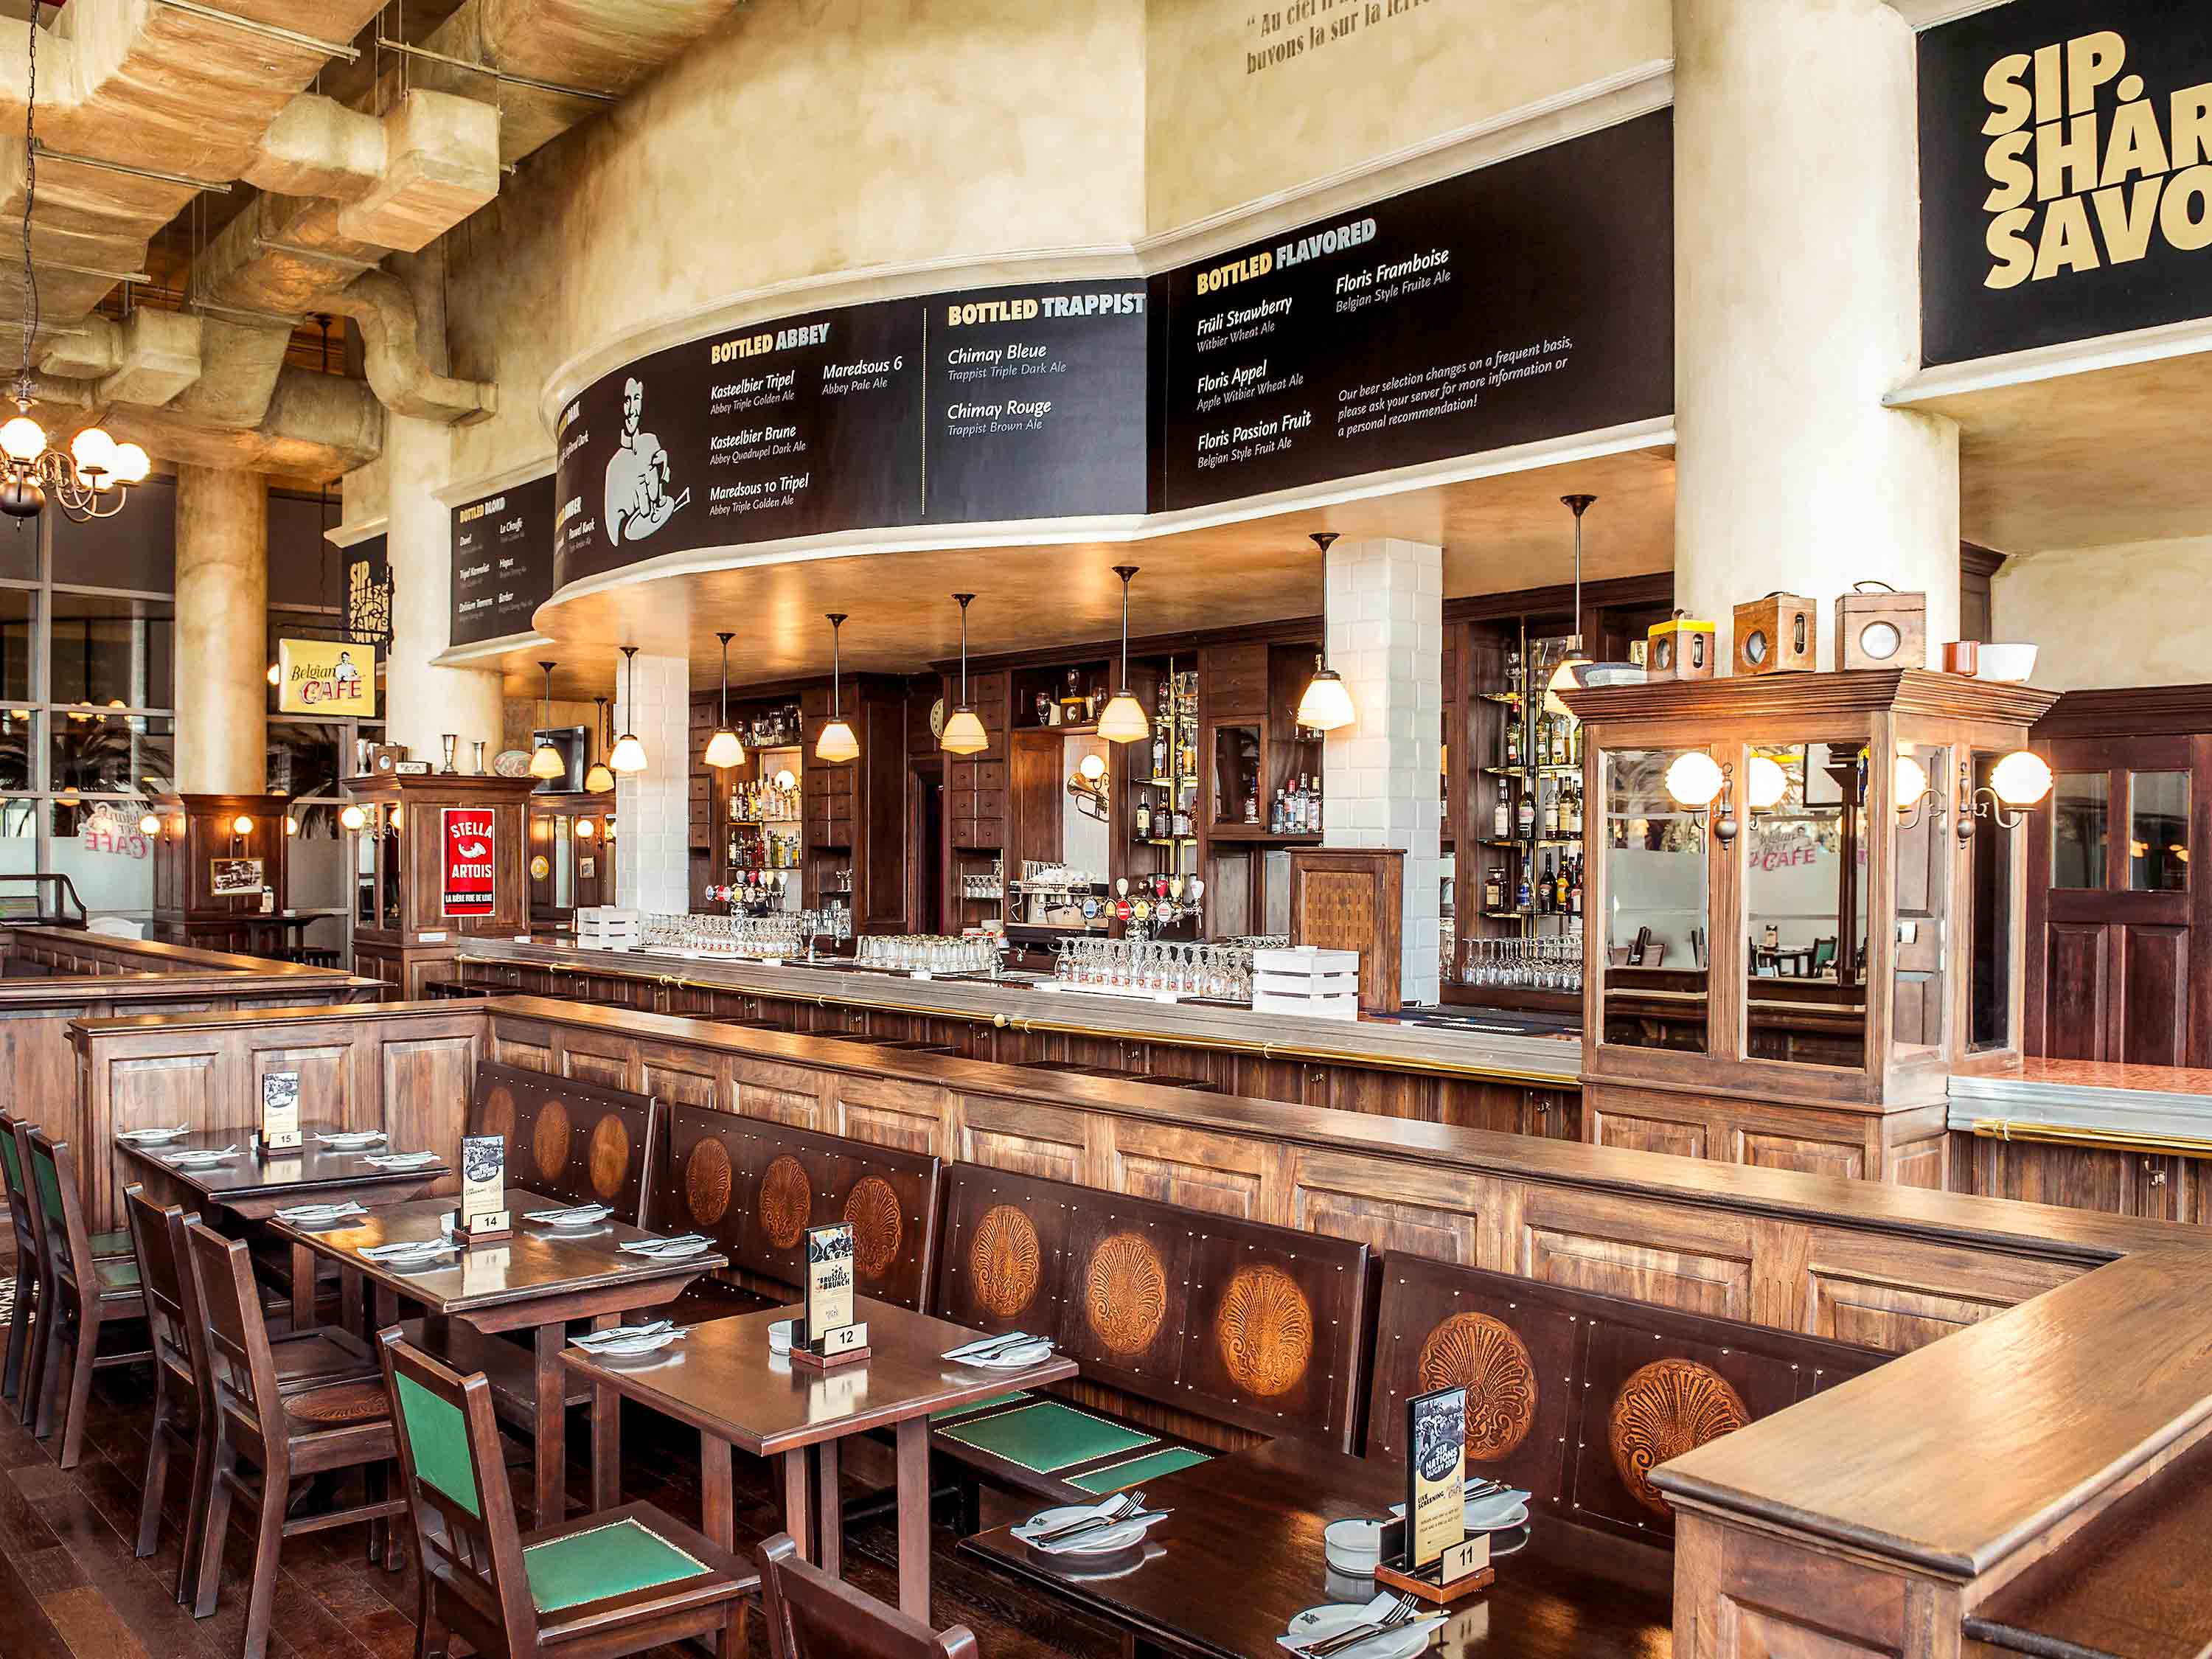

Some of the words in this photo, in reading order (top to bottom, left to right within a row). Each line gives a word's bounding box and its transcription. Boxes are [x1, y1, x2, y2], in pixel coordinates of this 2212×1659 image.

[1261, 12, 1281, 37] Au
[1247, 35, 1304, 74] buvons
[1310, 26, 1324, 49] la
[1331, 13, 1358, 41] sur
[1365, 3, 1380, 27] la
[1981, 30, 2144, 136] SIP.
[1197, 252, 1273, 296] BOTTLED
[1276, 218, 1377, 270] FLAVORED
[1336, 270, 1372, 294] Floris
[1376, 248, 1449, 282] Framboise
[1336, 295, 1371, 313] Belgian
[1374, 285, 1399, 302] Style
[1402, 277, 1431, 294] Fruite
[1433, 269, 1451, 285] Ale
[948, 299, 1038, 326] BOTTLED
[1042, 293, 1147, 318] TRAPPIST
[1197, 313, 1223, 335] Früli
[1226, 297, 1292, 327] Strawberry
[711, 334, 773, 364] BOTTLED
[776, 323, 830, 351] ABBEY
[1197, 335, 1228, 352] Witbier
[1231, 327, 1258, 343] Wheat
[1261, 320, 1275, 335] Ale
[947, 348, 1002, 365] Chimay
[1007, 343, 1047, 359] Bleue
[823, 360, 890, 380] Maredsous
[894, 355, 902, 370] 6
[948, 368, 987, 383] Trappist
[990, 364, 1018, 378] Triple
[1021, 363, 1046, 375] Dark
[1050, 361, 1067, 372] Ale
[1197, 372, 1229, 394] Floris
[1231, 359, 1267, 387] Appel
[1338, 389, 1357, 402] Our
[1360, 385, 1380, 397] beer
[1382, 373, 1423, 392] selection
[1425, 363, 1467, 381] changes
[1469, 359, 1483, 371] on
[1485, 357, 1492, 366] a
[1493, 344, 1540, 369] frequent
[1543, 336, 1573, 353] basis,
[711, 378, 763, 400] Kasteelbier
[765, 369, 795, 391] Tripel
[822, 383, 849, 395] Abbey
[851, 379, 871, 392] Pale
[873, 378, 888, 389] Ale
[1196, 394, 1221, 413] Apple
[1223, 387, 1255, 403] Witbier
[1258, 378, 1287, 395] Wheat
[1289, 373, 1304, 387] Ale
[1338, 406, 1366, 423] please
[1368, 397, 1385, 412] ask
[1387, 395, 1409, 411] your
[1411, 388, 1440, 403] server
[1439, 382, 1457, 400] for
[1458, 378, 1485, 392] more
[1488, 361, 1552, 387] information
[1555, 358, 1568, 369] or
[710, 403, 731, 415] Abbey
[734, 399, 751, 411] Triple
[754, 394, 780, 406] Golden
[782, 390, 794, 401] Ale
[947, 403, 1002, 420] Chimay
[1006, 400, 1051, 418] Rouge
[948, 423, 987, 438] Trappist
[990, 422, 1023, 434] Brown
[1026, 419, 1043, 430] Ale
[1338, 428, 1344, 437] a
[1346, 414, 1386, 439] personal
[1389, 394, 1478, 425] recommendation!
[710, 428, 762, 451] Kasteelbier
[765, 426, 796, 441] Brune
[1198, 431, 1229, 451] Floris
[1233, 420, 1278, 442] Passion
[1281, 410, 1312, 432] Fruit
[710, 454, 731, 465] Abbey
[732, 445, 771, 463] Quadrupel
[772, 442, 791, 455] Dark
[793, 440, 806, 452] Ale
[1198, 453, 1228, 469] Belgian
[1231, 446, 1252, 462] Style
[1255, 441, 1275, 456] Fruit
[1277, 437, 1292, 451] Ale
[710, 481, 762, 501] Maredsous
[765, 481, 776, 493] 10
[779, 472, 810, 493] Tripel
[709, 504, 731, 515] Abbey
[732, 501, 751, 513] Triple
[753, 497, 779, 509] Golden
[782, 495, 794, 506] Ale
[291, 664, 336, 681] Belgian
[451, 822, 492, 838] STELLA
[452, 864, 492, 878] ARTOIS
[484, 1217, 497, 1226] 14
[820, 1271, 847, 1284] BRUSSELS
[824, 1278, 850, 1290] BRUNCH
[839, 1330, 854, 1343] 12
[1425, 1447, 1458, 1472] NATIONS
[1436, 1443, 1447, 1456] SIX
[1426, 1462, 1444, 1479] RUGBY
[1418, 1493, 1428, 1503] LIVE
[1418, 1491, 1444, 1509] SCREENING
[1460, 1546, 1473, 1566] 11
